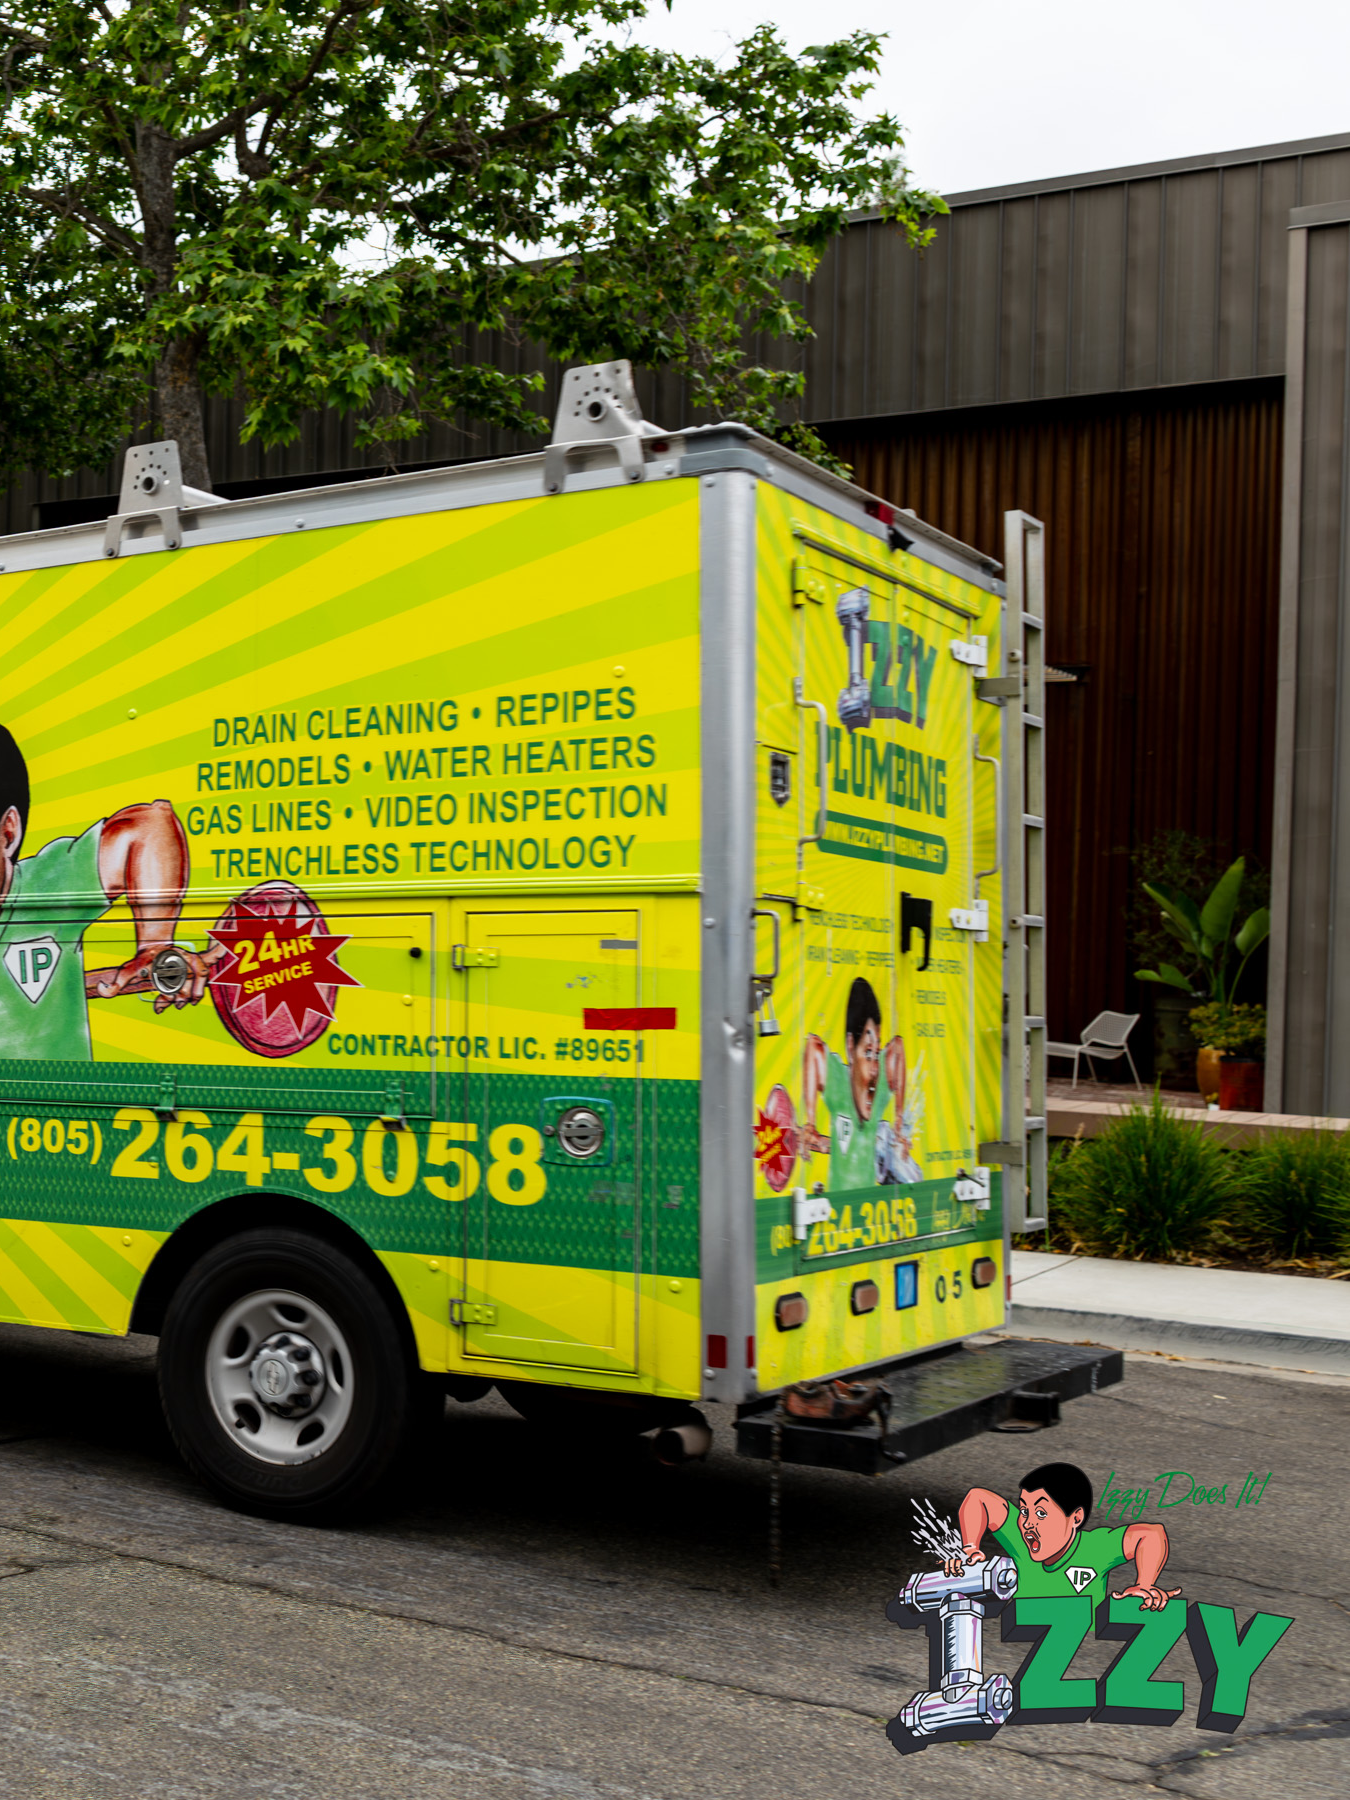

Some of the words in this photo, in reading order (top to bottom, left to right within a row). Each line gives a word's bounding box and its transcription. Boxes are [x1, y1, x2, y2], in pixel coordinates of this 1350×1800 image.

[213, 712, 296, 747] DRAIN
[307, 700, 458, 741] CLEANING
[496, 686, 636, 727] REPIPES
[197, 753, 350, 792] REMODELS
[385, 745, 491, 782] WATER
[503, 734, 656, 775] HEATERS
[814, 721, 947, 819] PLUMBING
[187, 804, 242, 836] GAS
[253, 800, 331, 833] LINES
[365, 794, 457, 827] VIDEO
[469, 783, 667, 823] INSPECTION
[210, 842, 399, 878] TRENCHLESS
[409, 834, 637, 873] TECHNOLOGY
[18, 947, 53, 984] IP
[233, 931, 316, 974] 24HR
[243, 961, 314, 994] SERVICE
[327, 1033, 490, 1058] CONTRACTOR
[499, 1036, 546, 1060] LIC.
[554, 1037, 645, 1062] #89651
[7, 1117, 103, 1165] (805)
[110, 1107, 548, 1206] 264-3058
[807, 1197, 918, 1257] 264-3058
